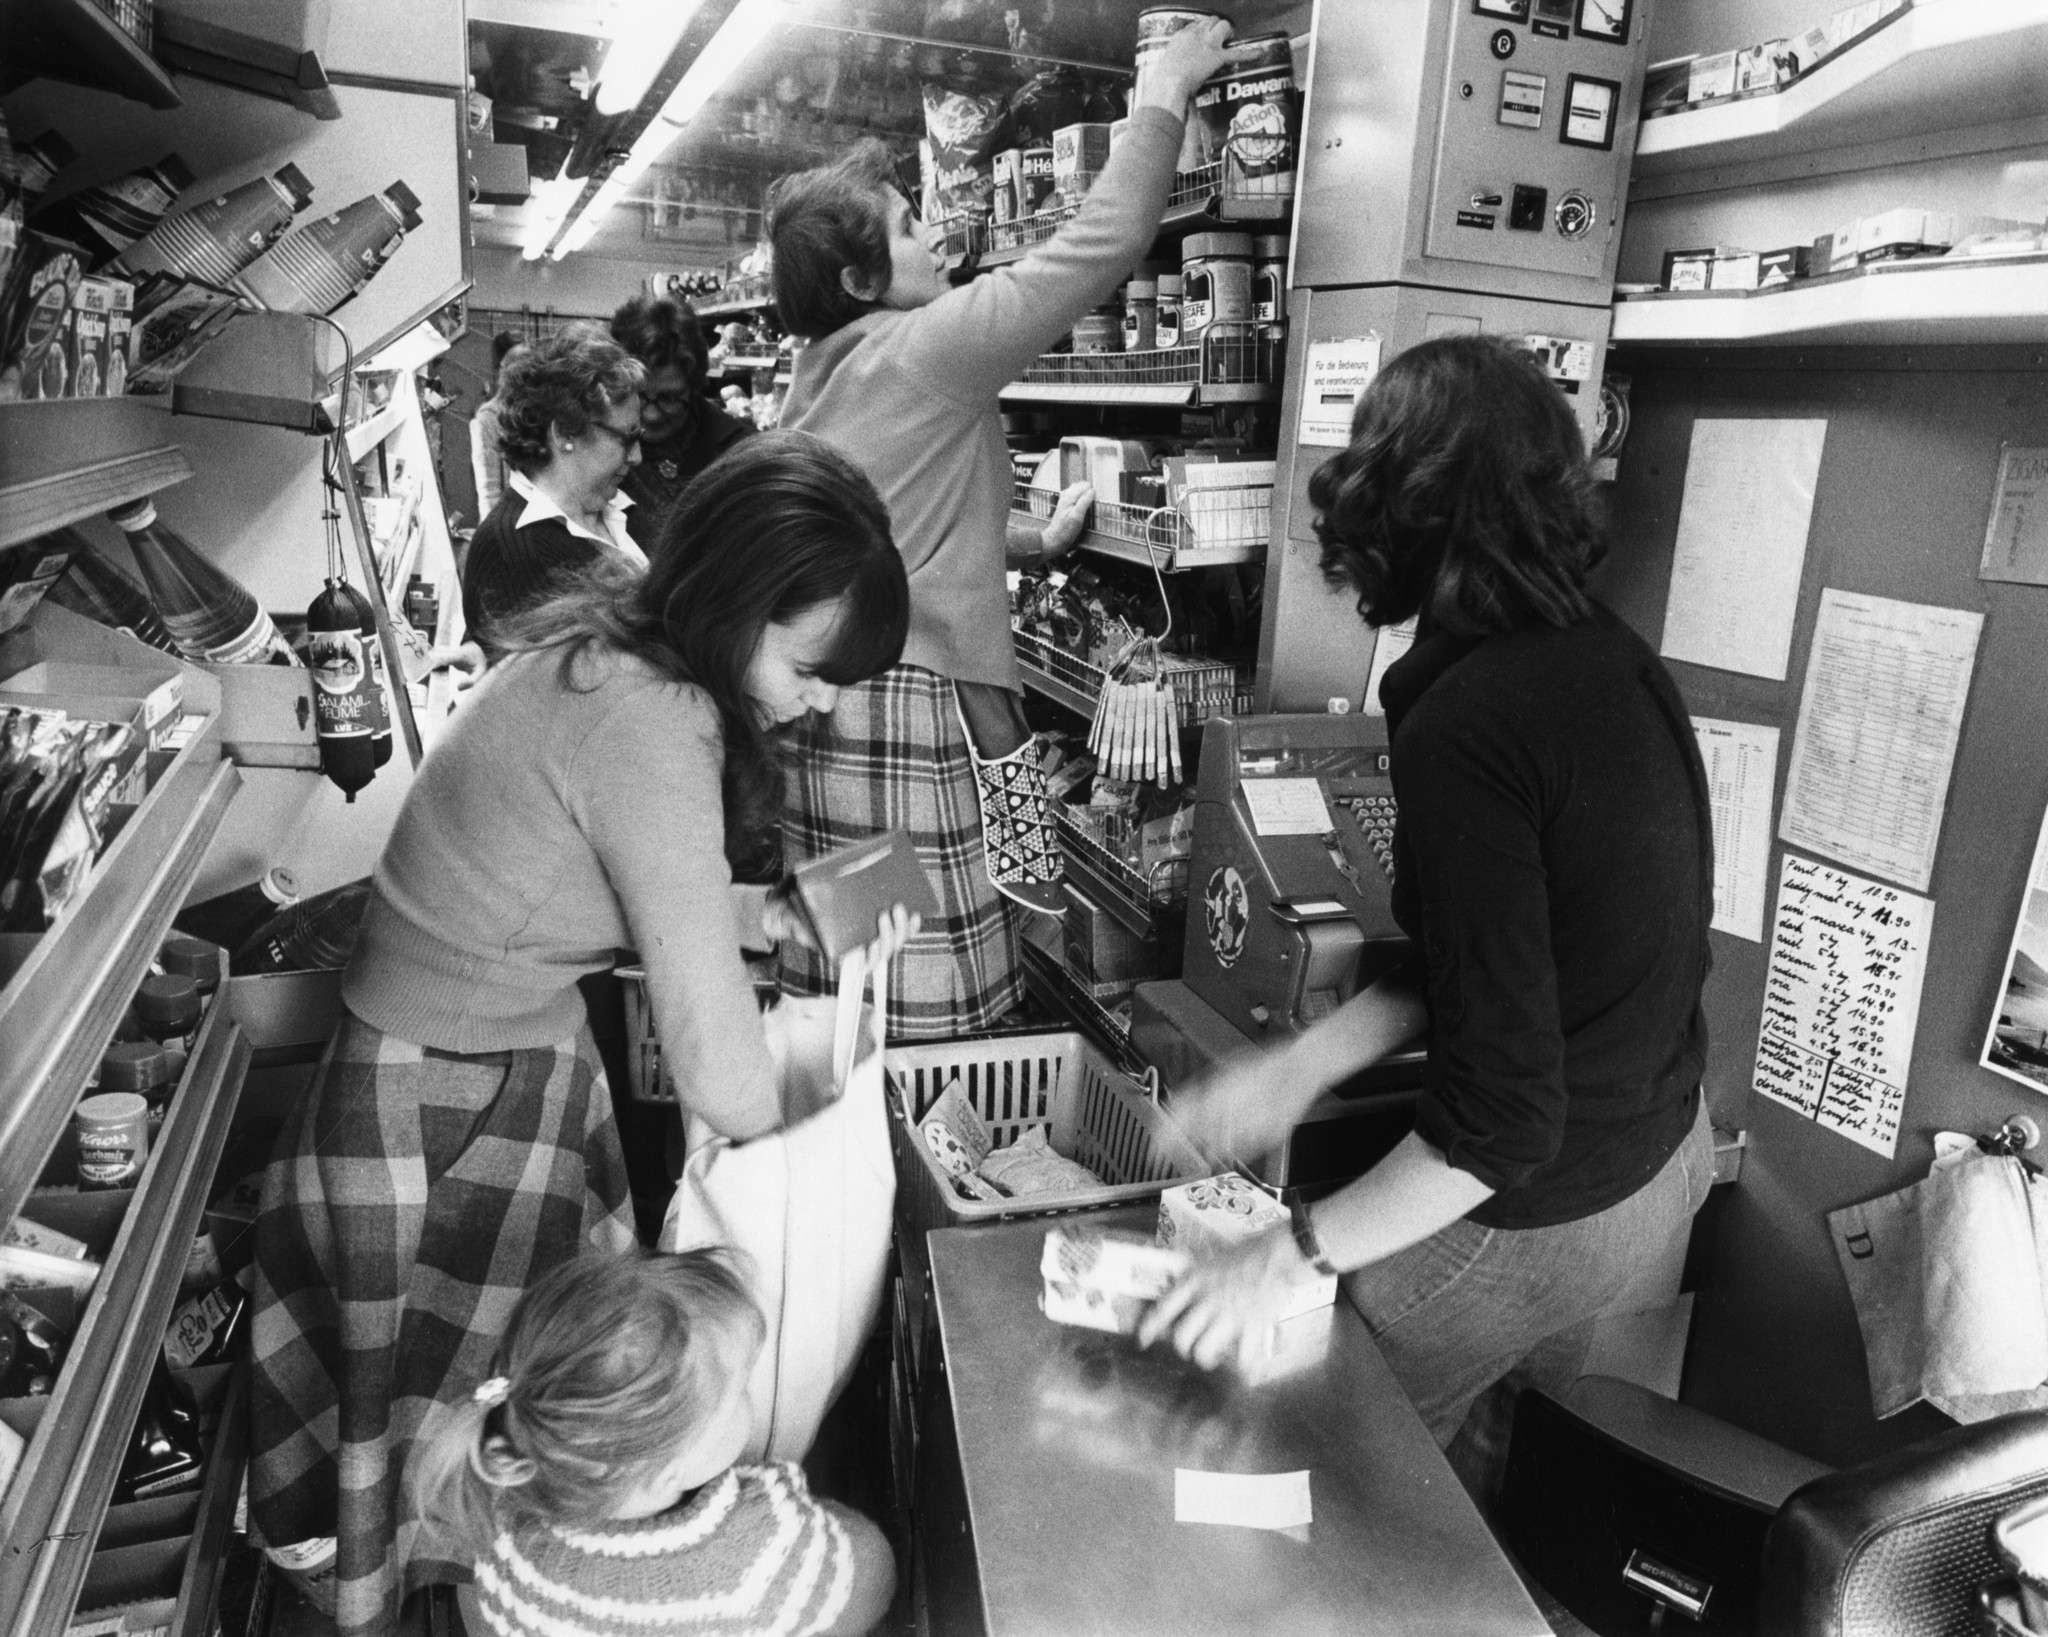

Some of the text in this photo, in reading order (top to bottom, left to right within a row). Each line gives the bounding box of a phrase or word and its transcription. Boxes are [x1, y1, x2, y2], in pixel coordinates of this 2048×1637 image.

[1502, 38, 1510, 50] R
[1233, 105, 1276, 133] Action
[1672, 270, 1701, 282] CAMEL
[1825, 871, 1834, 881] 4
[1862, 886, 1898, 901] 10.90
[1818, 947, 1828, 956] 5
[1865, 949, 1901, 963] 14.50
[1822, 983, 1840, 994] 4.5
[1862, 983, 1896, 999] 13.90
[1768, 992, 1796, 1006] omo
[1816, 1009, 1825, 1017] 5
[1849, 1025, 1884, 1043] 15.90
[1819, 996, 1827, 1004] 5
[1848, 1008, 1884, 1026] 14.90
[1820, 1104, 1868, 1129] comfort
[1845, 1228, 1875, 1260] D
